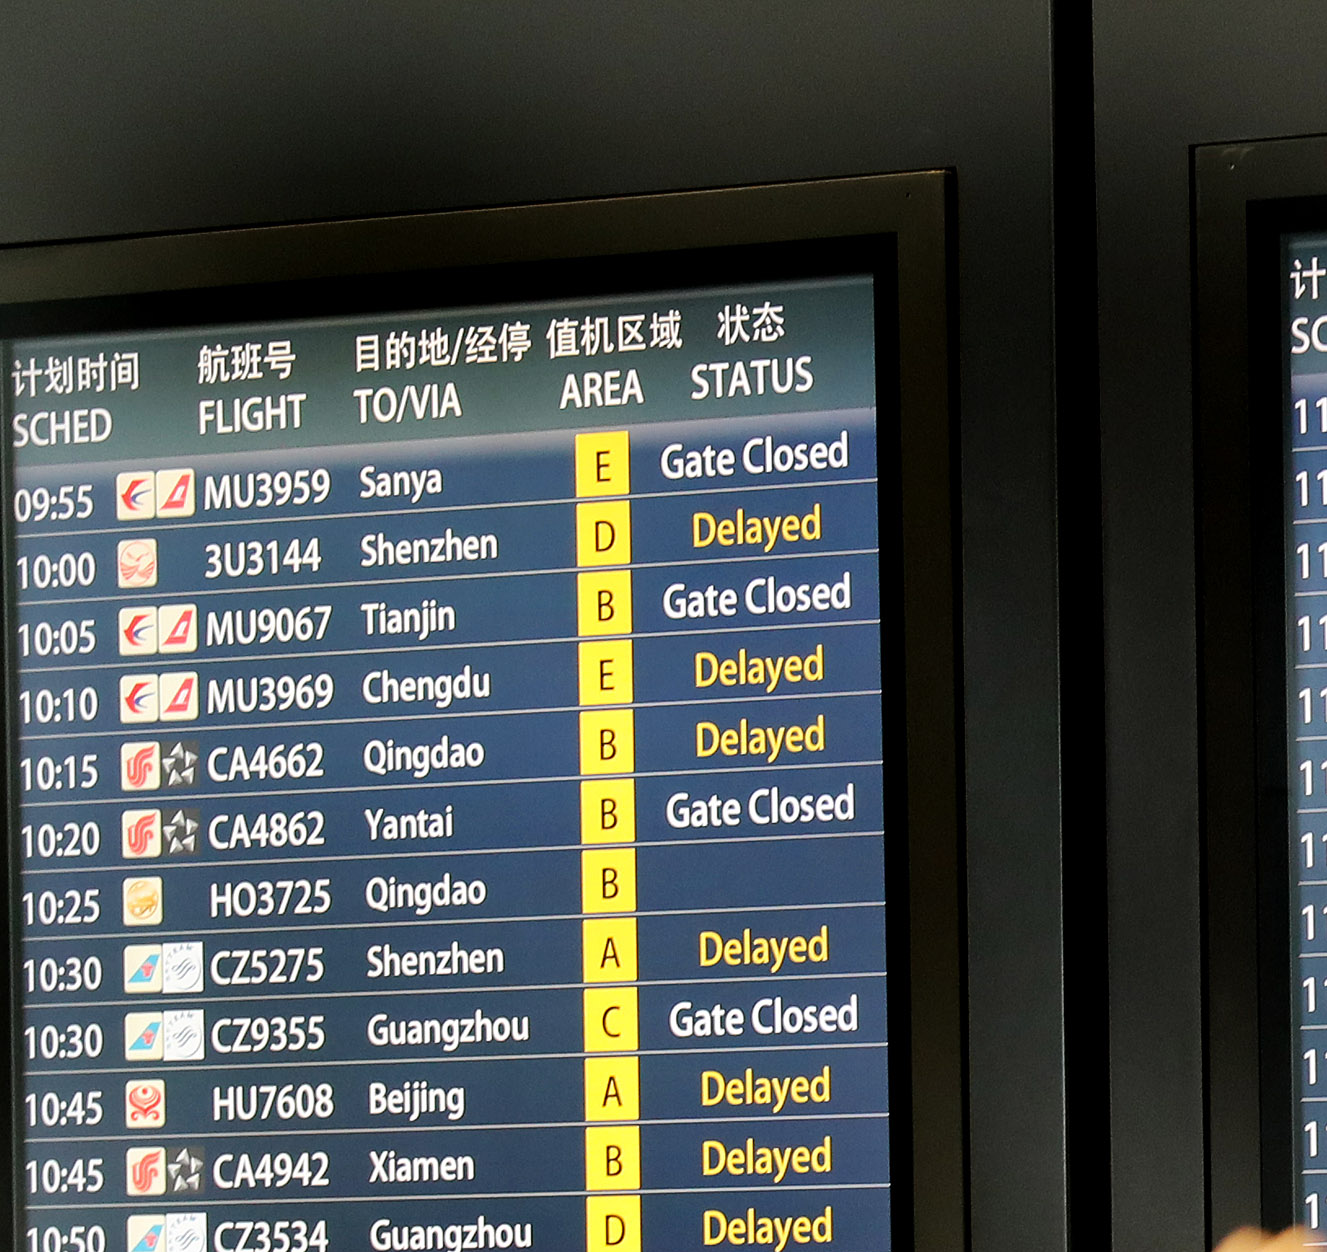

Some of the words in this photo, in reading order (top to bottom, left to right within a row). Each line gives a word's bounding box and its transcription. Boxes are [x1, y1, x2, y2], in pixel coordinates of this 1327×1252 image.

[11, 352, 139, 397] 计划时间
[197, 340, 296, 384] 航班号
[355, 320, 532, 373] 目的地/经停
[545, 309, 683, 360] 值机区域
[717, 301, 785, 346] 状态
[13, 408, 112, 448] SCHED
[199, 393, 307, 435] FLIGHT
[353, 382, 462, 424] TO/VIA
[559, 369, 644, 410] AREA
[691, 355, 814, 400] STATUS
[14, 484, 93, 523] 09:55
[204, 468, 330, 511] MU3959
[359, 465, 443, 504] Sanya
[595, 449, 612, 483] E
[660, 443, 736, 480] Gate
[742, 430, 848, 474] Closed
[19, 686, 98, 724] 10:10
[207, 673, 334, 714] MU3969
[362, 664, 490, 709] Chengdu
[599, 658, 615, 691] E
[694, 643, 824, 694] Delayed
[22, 888, 100, 926] 10:25
[210, 878, 331, 918] HO3725
[365, 872, 487, 916] Qingdao
[601, 867, 619, 900] B
[24, 1023, 103, 1060] 10:30
[211, 1015, 325, 1054] CZ9355
[367, 1008, 529, 1052] Guangzhou
[601, 1005, 621, 1039] C
[669, 1001, 745, 1038] Gate
[751, 993, 858, 1035] Closed
